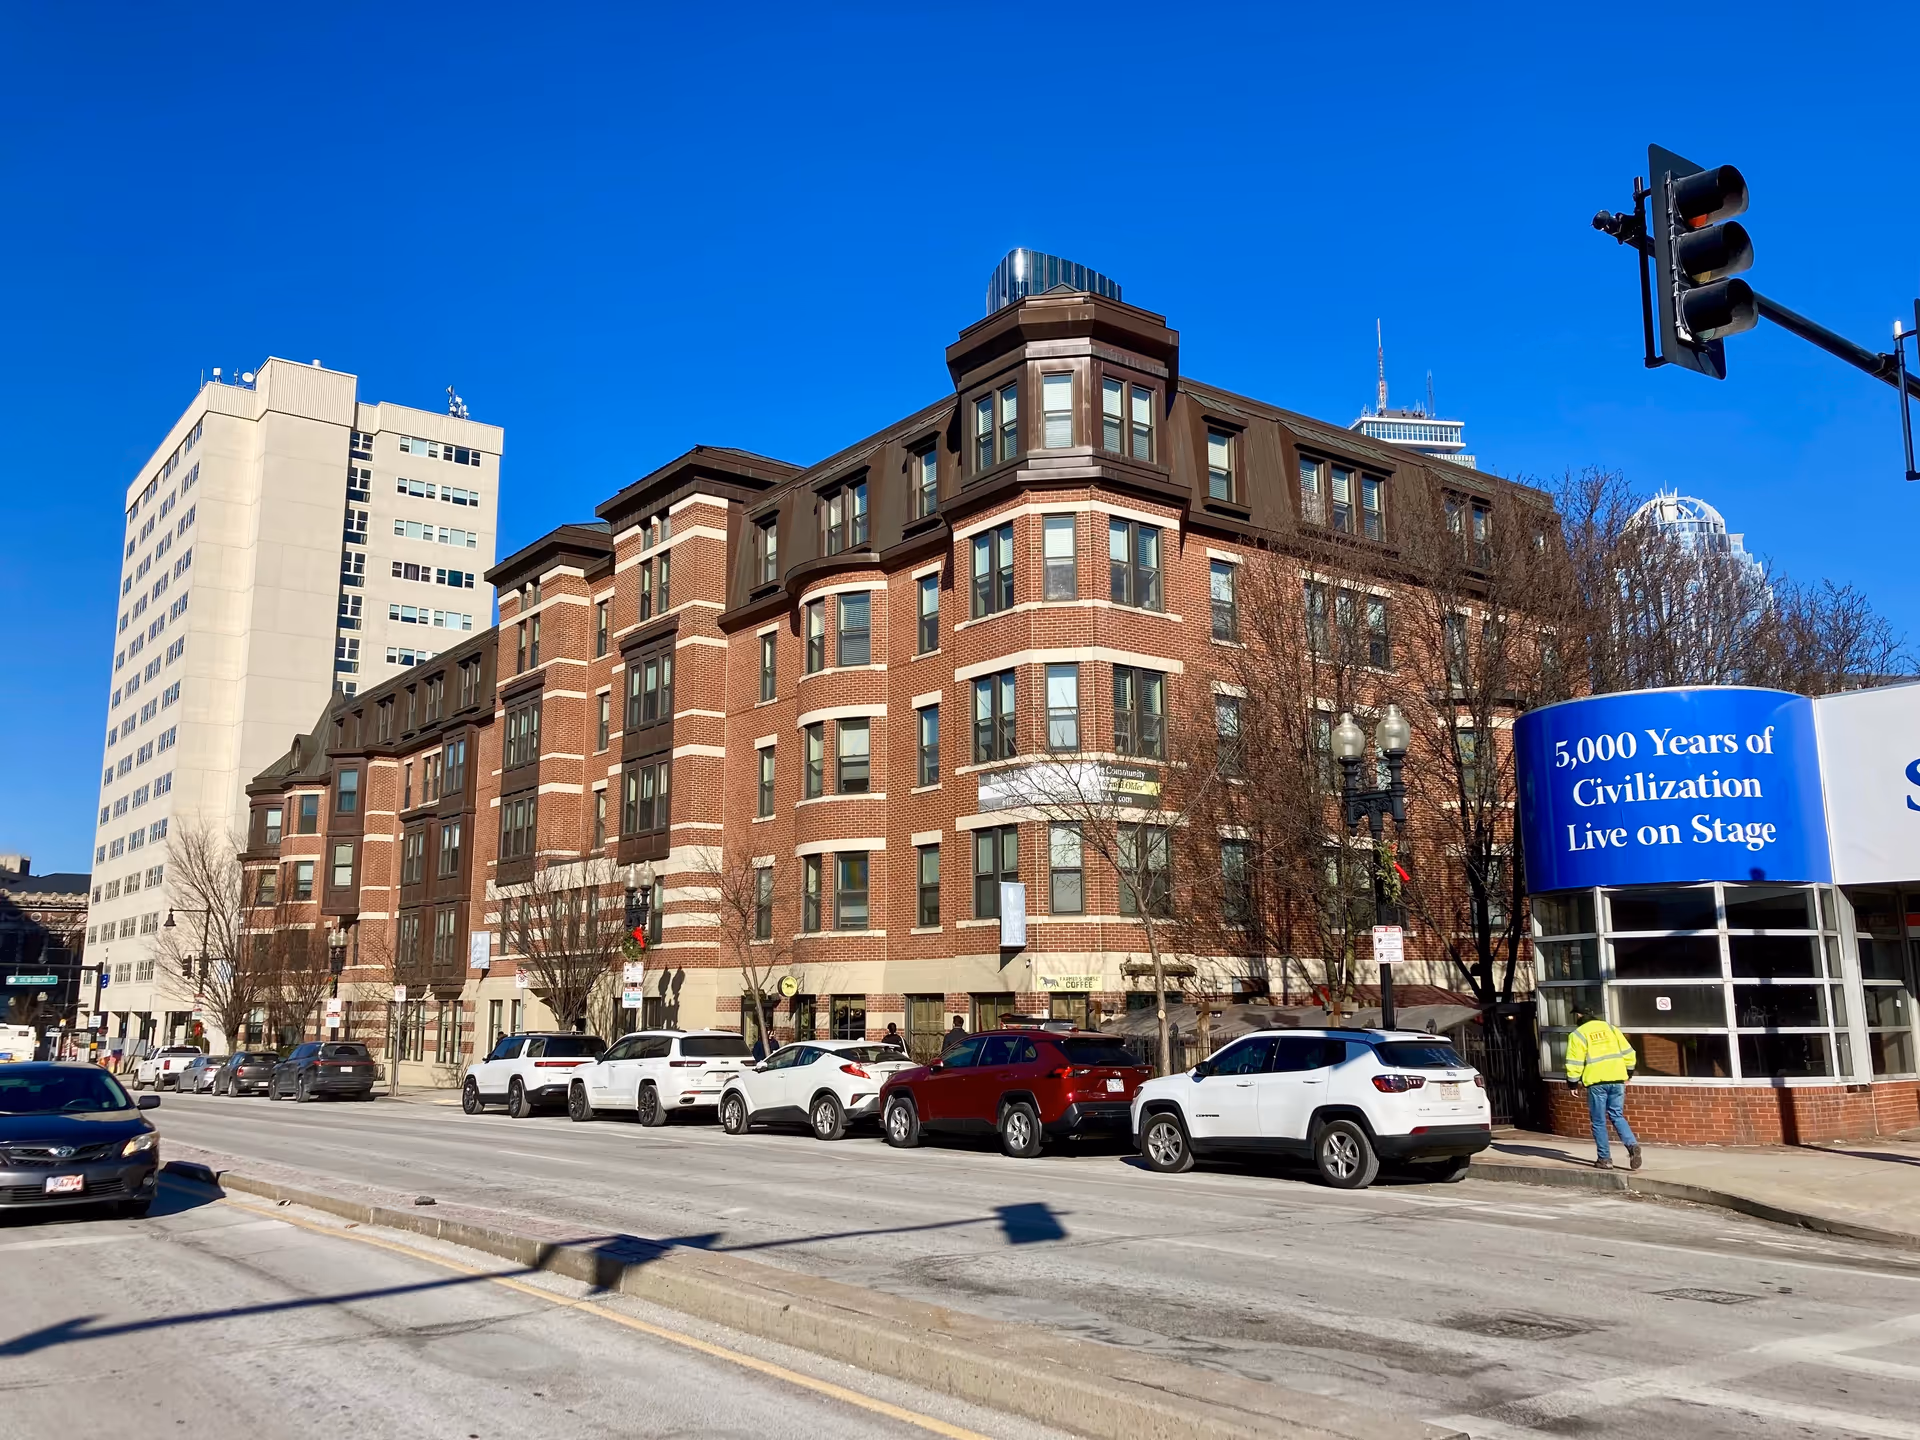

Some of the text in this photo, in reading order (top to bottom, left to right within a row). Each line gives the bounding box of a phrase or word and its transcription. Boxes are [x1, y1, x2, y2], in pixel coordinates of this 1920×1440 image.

[1555, 726, 1775, 769] 5,000 Years of
[1105, 765, 1146, 780] Community
[1572, 770, 1763, 807] Civilization
[1566, 814, 1777, 852] Live on Stage
